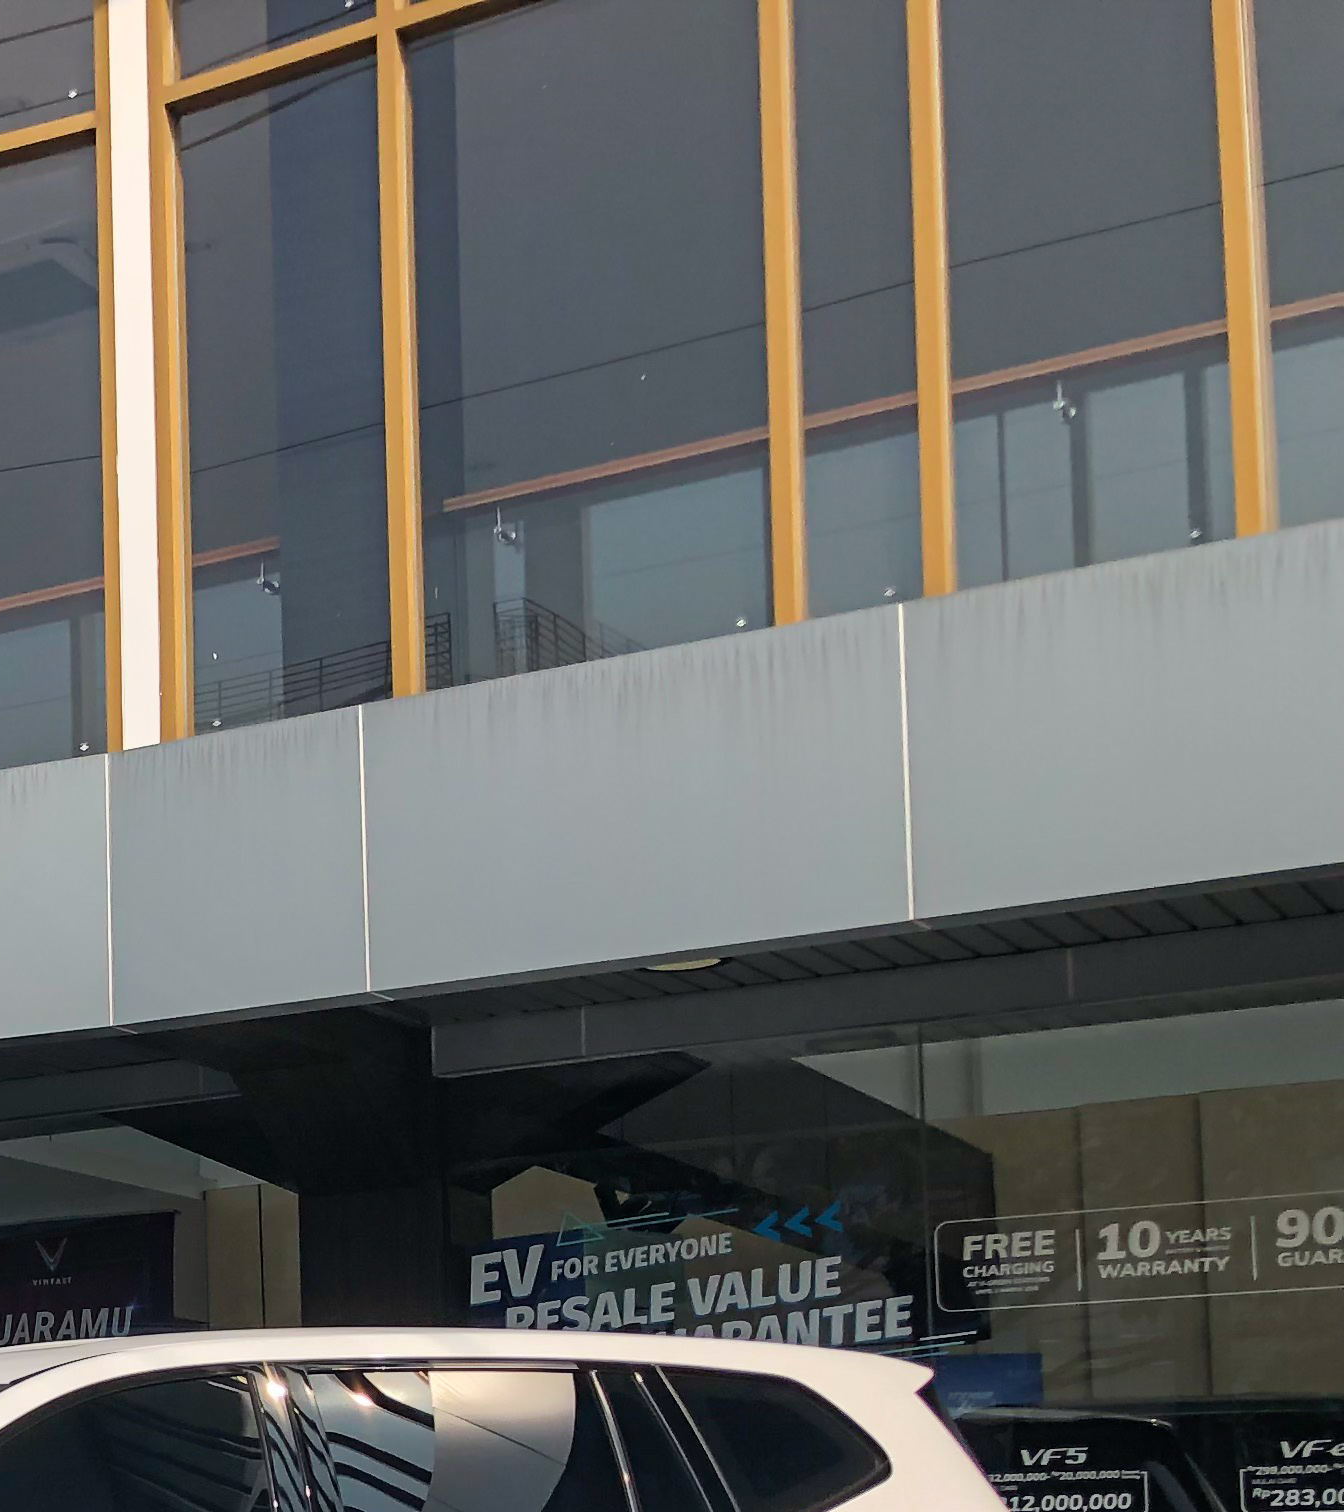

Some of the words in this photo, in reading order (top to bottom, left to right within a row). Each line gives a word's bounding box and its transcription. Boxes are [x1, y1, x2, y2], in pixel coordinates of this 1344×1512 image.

[962, 1229, 1056, 1261] FREE
[1096, 1220, 1160, 1260] 10
[1165, 1226, 1232, 1245] YEARS
[470, 1244, 545, 1306] EV
[551, 1255, 599, 1282] FOR
[604, 1232, 733, 1273] EVERYONE
[962, 1260, 1056, 1279] CHARGING
[1097, 1256, 1231, 1279] WARRANTY
[687, 1255, 842, 1316] VALUE
[1020, 1446, 1089, 1467] VF5
